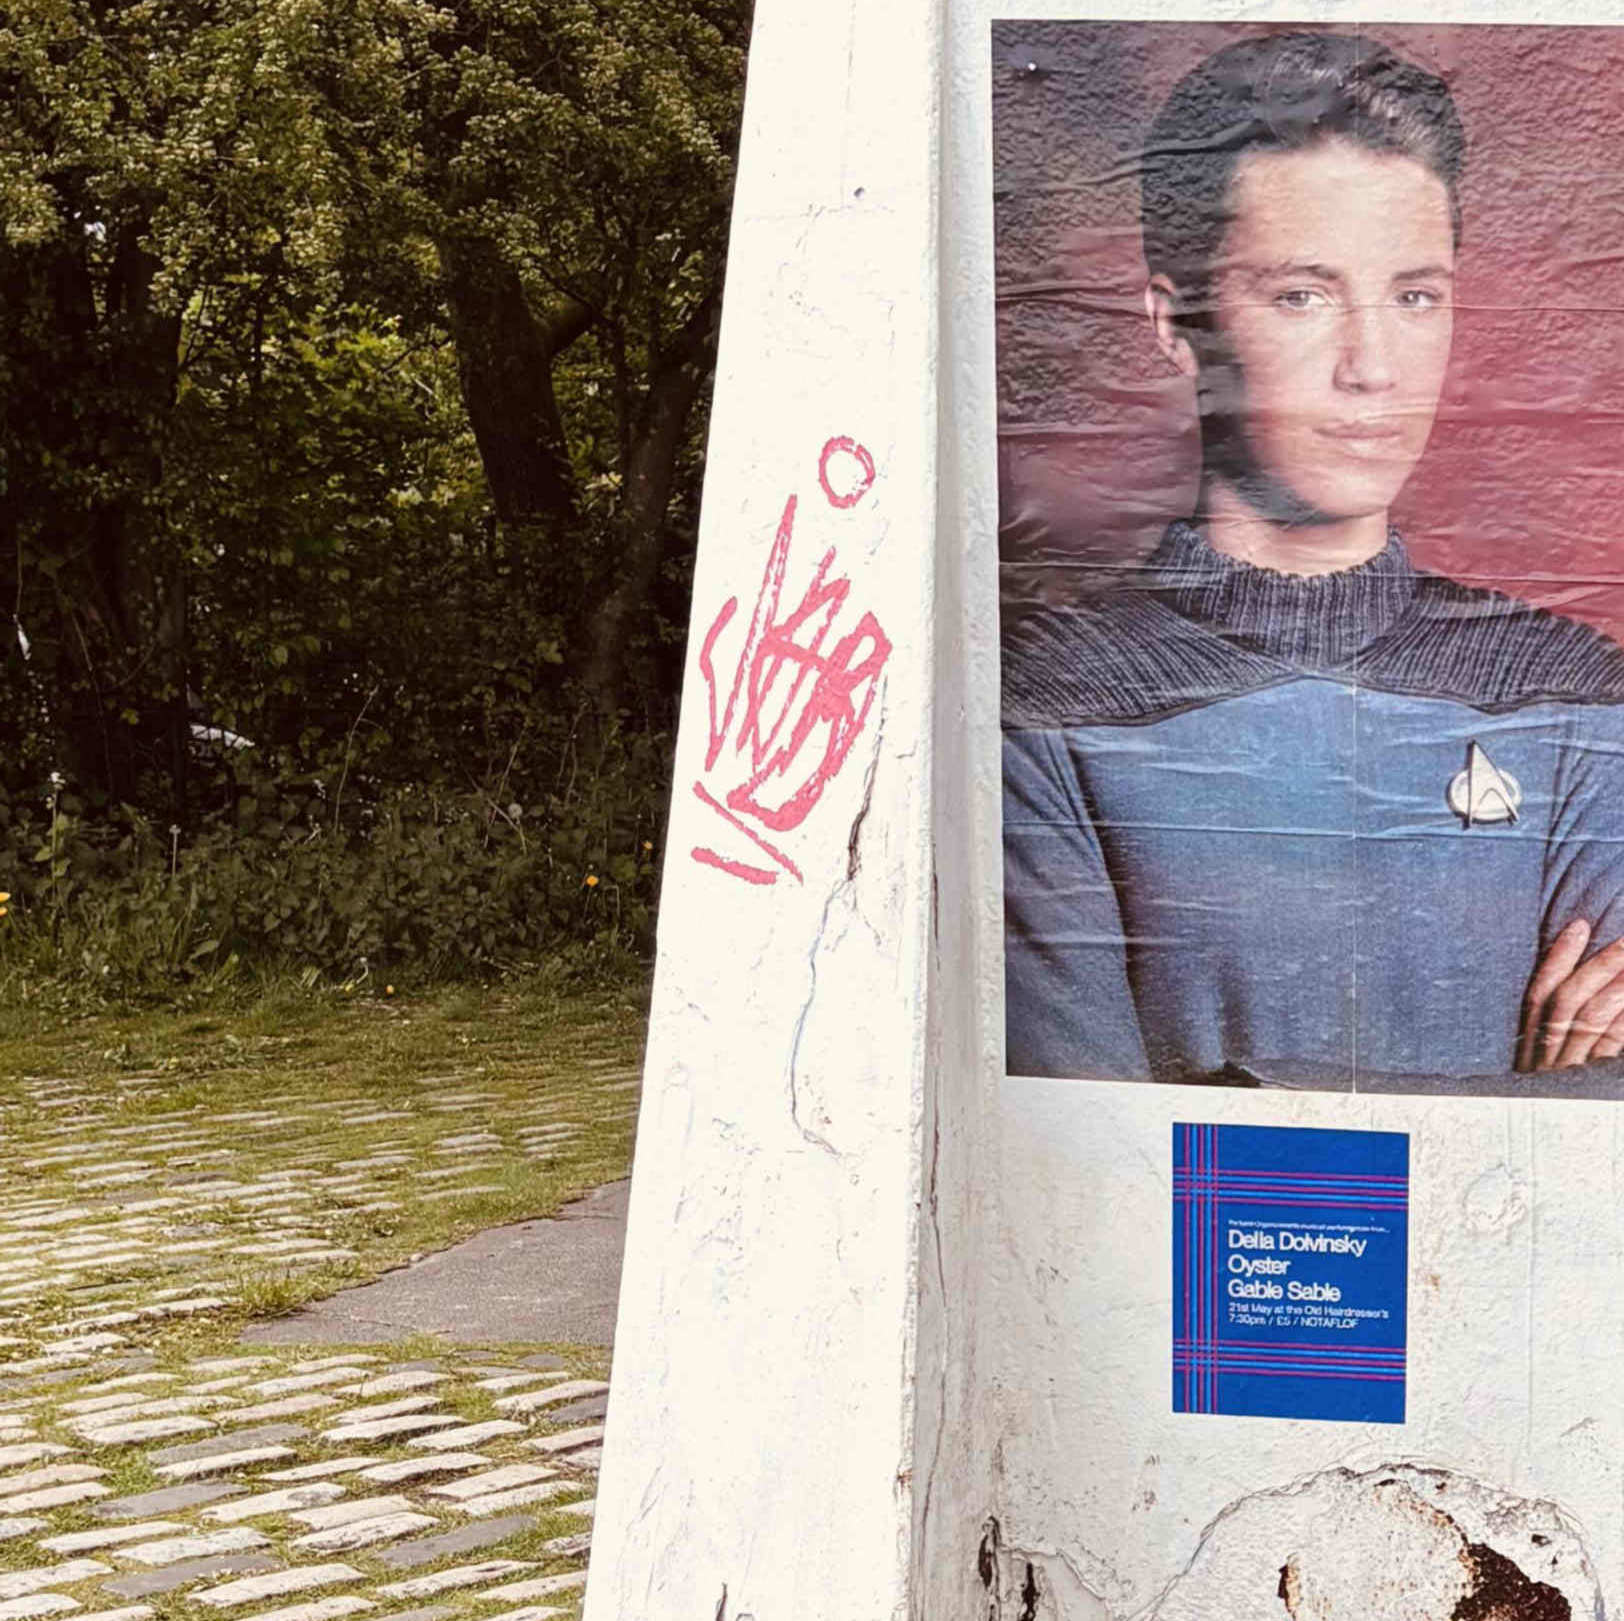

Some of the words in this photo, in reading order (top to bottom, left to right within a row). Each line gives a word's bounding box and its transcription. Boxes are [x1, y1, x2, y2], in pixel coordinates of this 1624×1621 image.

[1279, 1231, 1367, 1258] Dolvinsky
[1227, 1254, 1291, 1277] Oyster
[1228, 1279, 1283, 1299] Gable
[1287, 1281, 1341, 1302] Sable
[1228, 1302, 1249, 1313] 21st
[1251, 1303, 1272, 1315] May
[1274, 1304, 1284, 1314] at
[1286, 1304, 1302, 1315] the
[1304, 1305, 1322, 1315] Old
